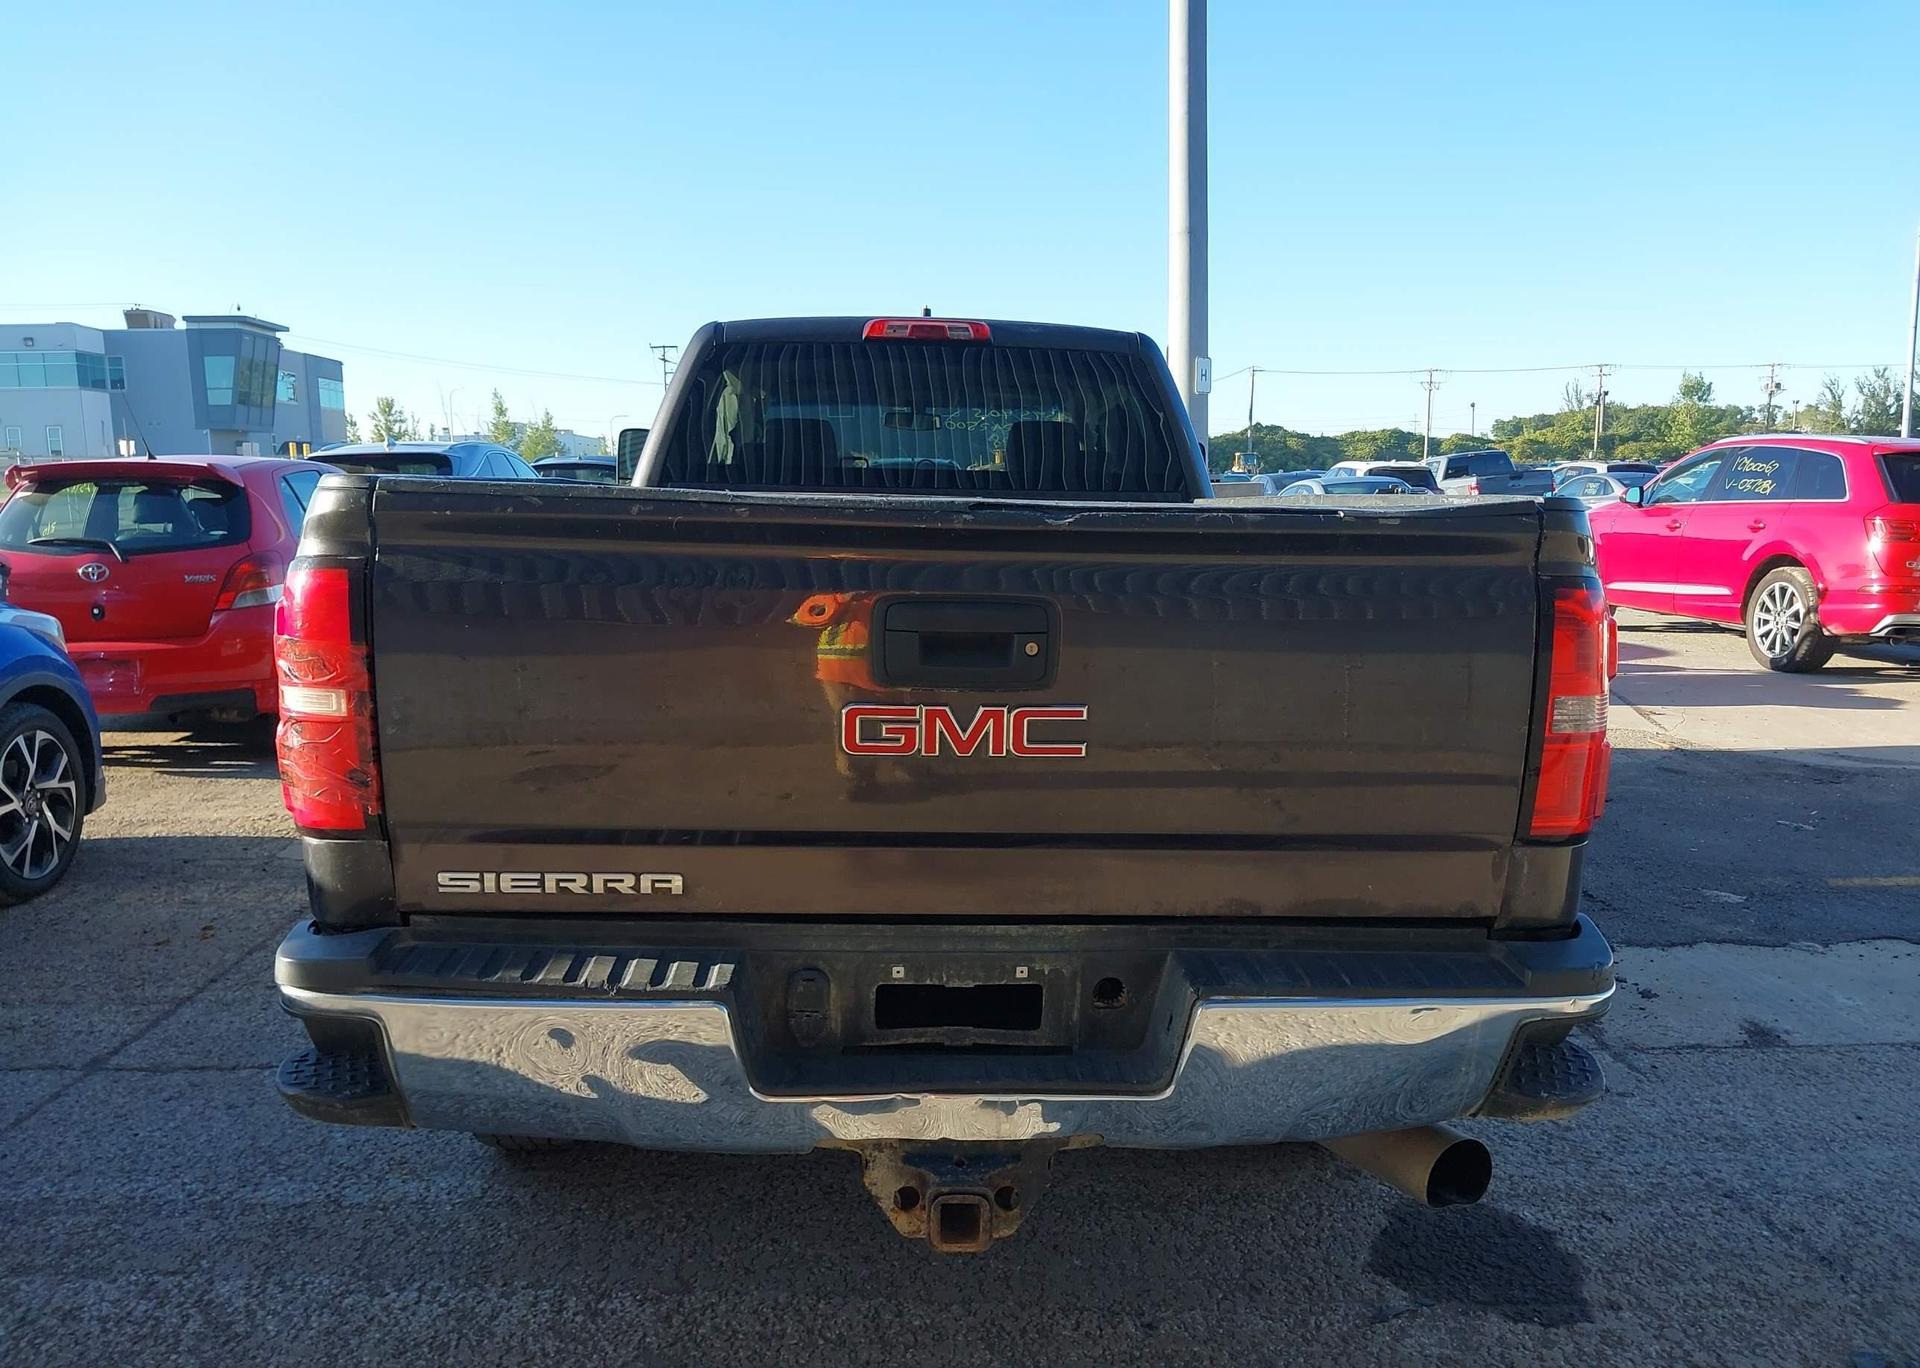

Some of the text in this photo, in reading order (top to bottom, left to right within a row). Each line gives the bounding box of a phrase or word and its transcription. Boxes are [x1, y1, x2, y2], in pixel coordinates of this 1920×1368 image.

[1200, 368, 1207, 382] H
[842, 704, 1089, 757] GMC
[437, 872, 684, 895] SIERRA
